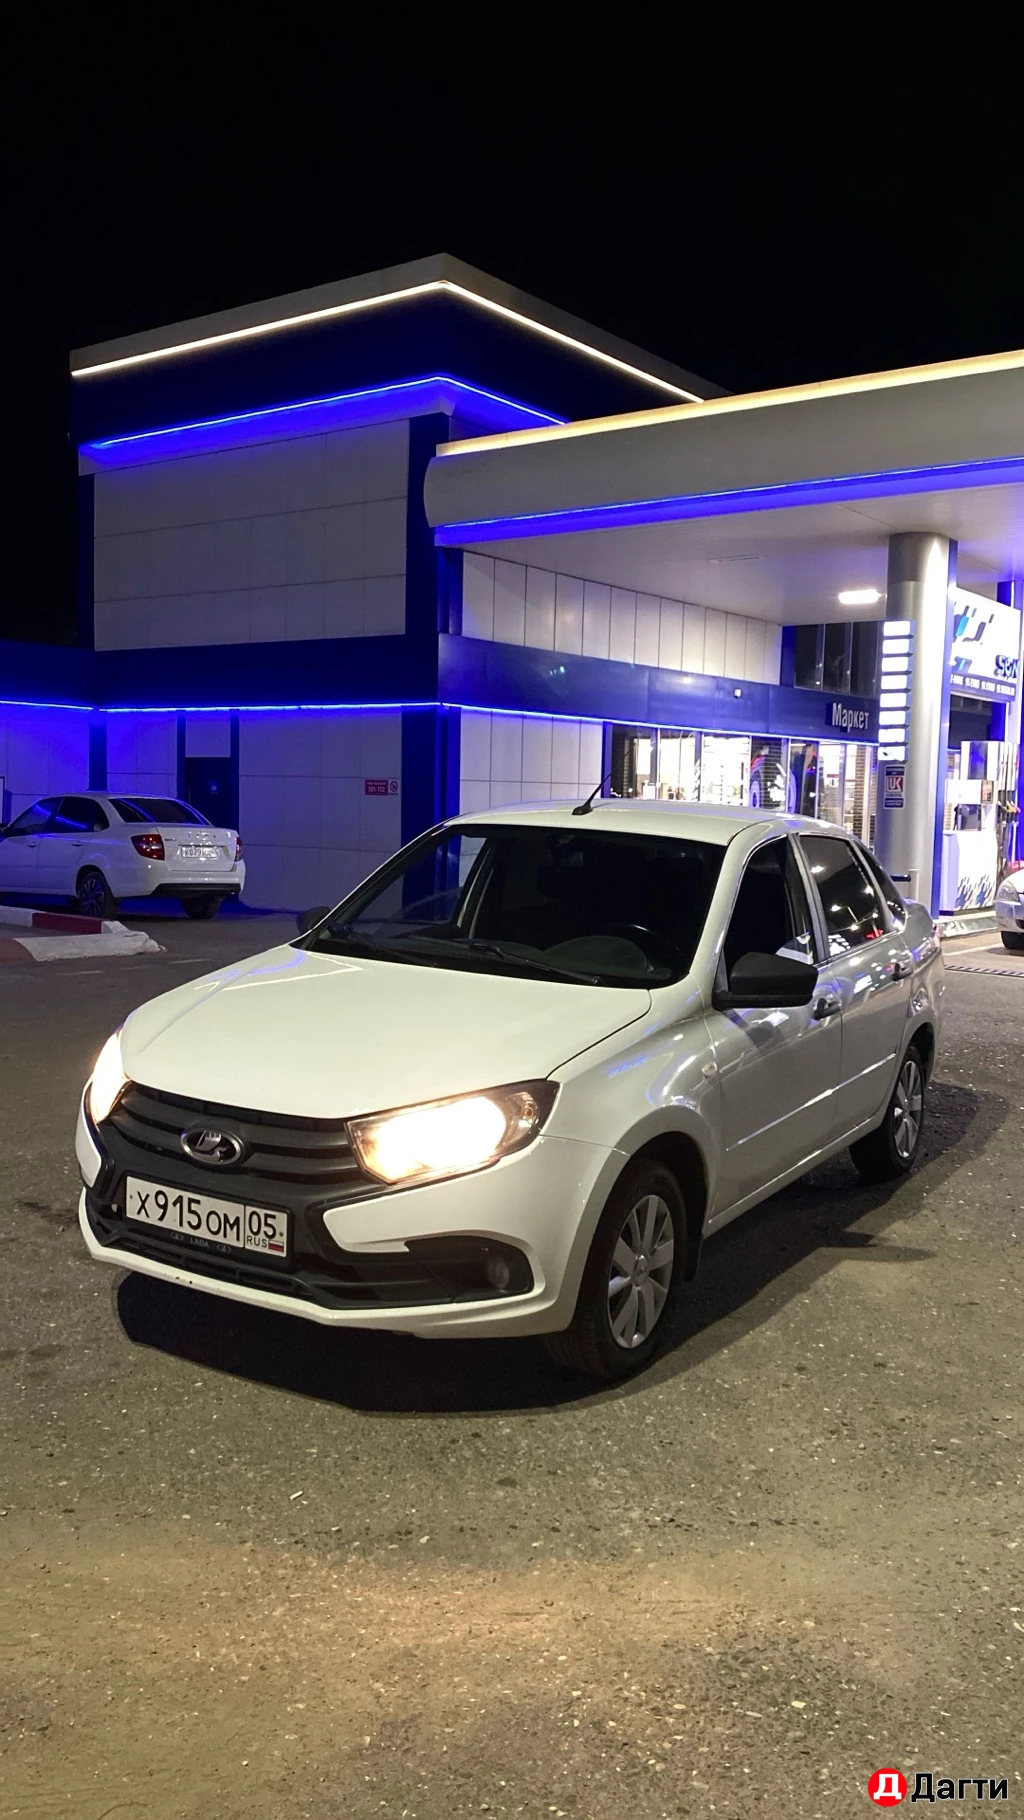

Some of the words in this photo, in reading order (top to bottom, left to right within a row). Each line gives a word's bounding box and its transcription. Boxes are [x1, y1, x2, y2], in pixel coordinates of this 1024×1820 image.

[832, 702, 869, 733] Маркет
[248, 1210, 277, 1239] 05
[190, 1237, 209, 1248] LADA
[246, 1235, 268, 1248] RUS
